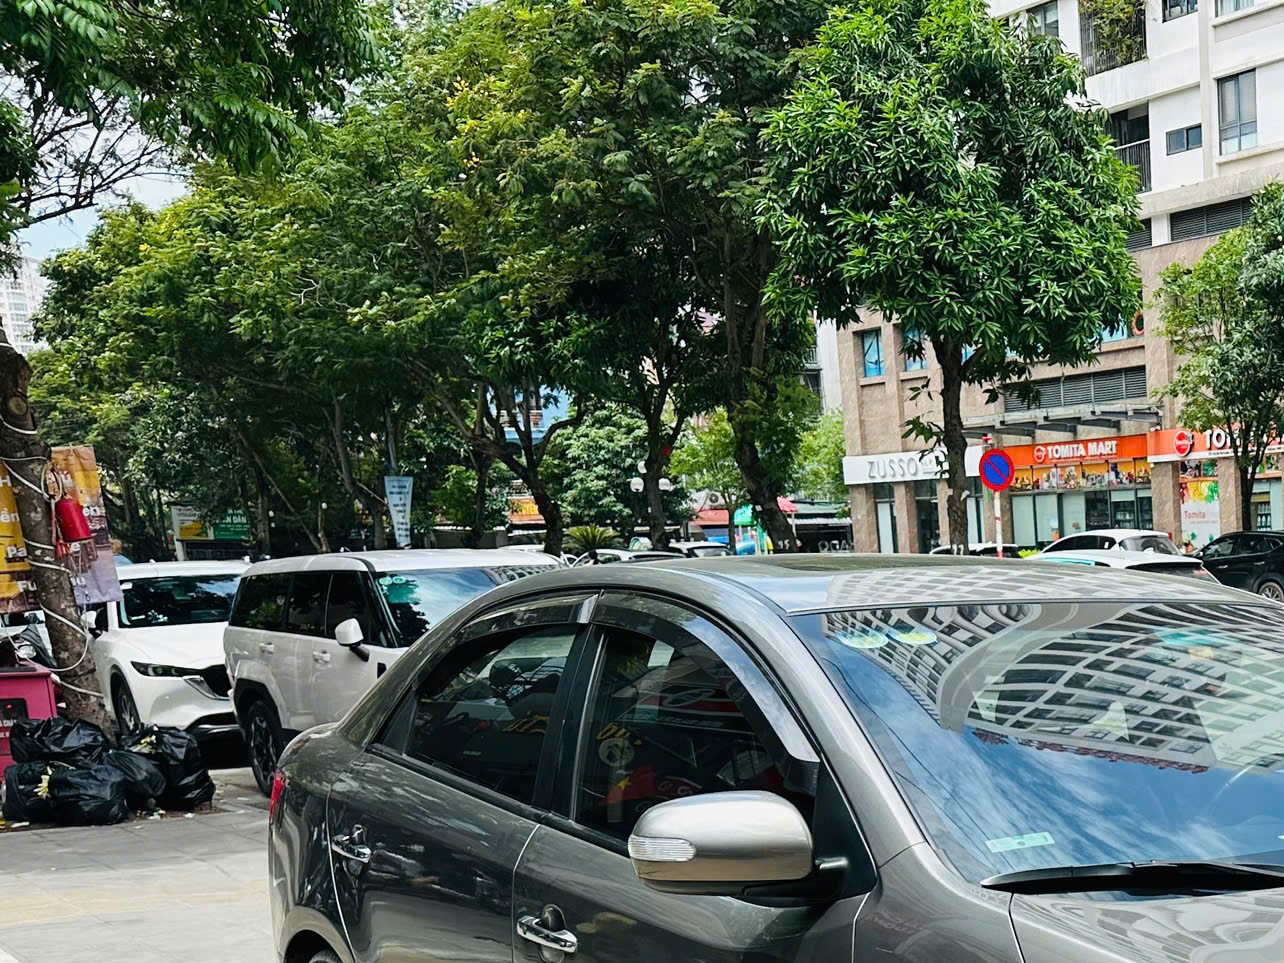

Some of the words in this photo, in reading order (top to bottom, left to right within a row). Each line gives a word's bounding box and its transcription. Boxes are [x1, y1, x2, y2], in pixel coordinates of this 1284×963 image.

[1047, 443, 1086, 459] TOMITA
[1087, 440, 1118, 456] MART
[867, 457, 918, 479] ZUSSO
